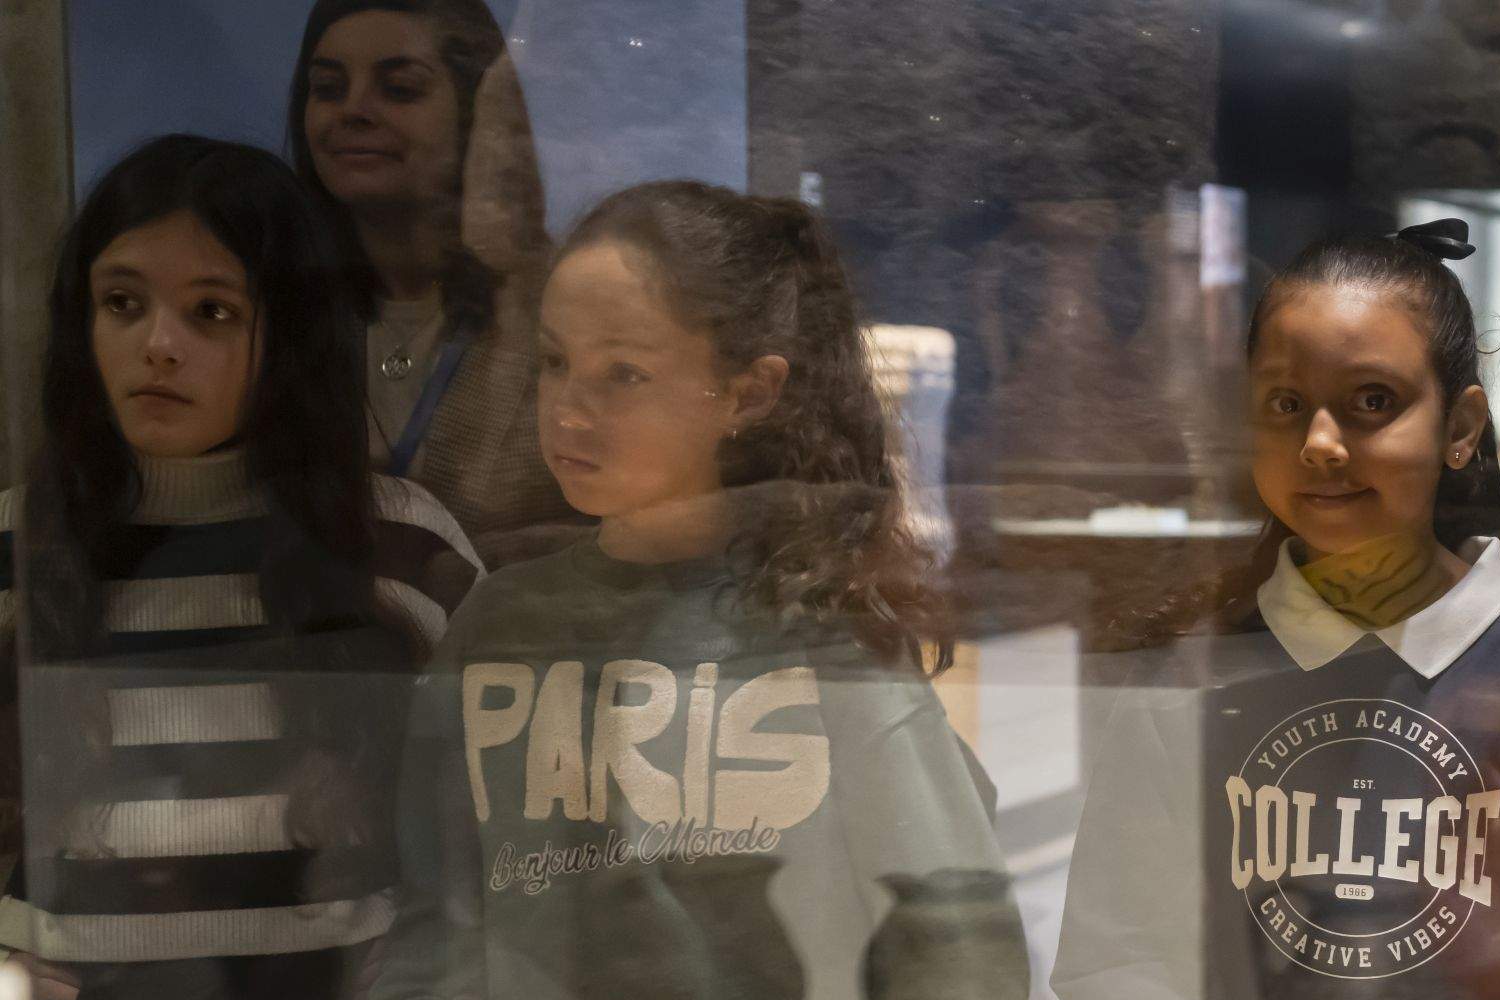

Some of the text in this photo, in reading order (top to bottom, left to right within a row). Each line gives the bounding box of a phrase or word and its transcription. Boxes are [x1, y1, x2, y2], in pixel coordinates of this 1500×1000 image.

[1258, 709, 1468, 780] YOUTH ACADEMY
[491, 815, 781, 895] Bonjour le Monde
[1259, 897, 1456, 968] CREATIVE VIBES
